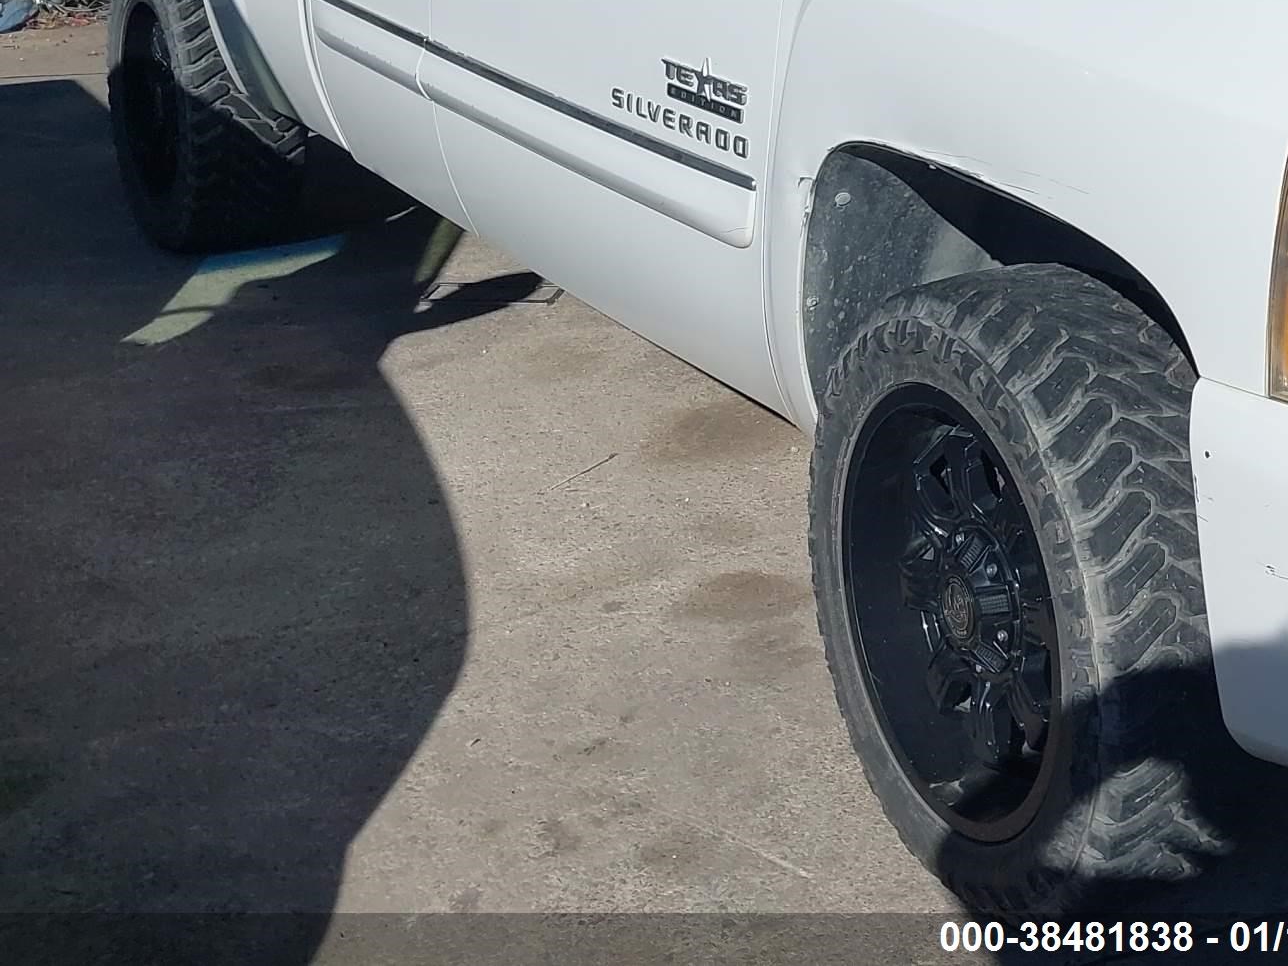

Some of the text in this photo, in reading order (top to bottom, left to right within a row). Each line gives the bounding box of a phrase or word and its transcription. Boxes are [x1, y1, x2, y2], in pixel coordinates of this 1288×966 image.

[661, 58, 749, 106] TEXAS
[669, 86, 738, 119] EDITION
[611, 87, 749, 159] SILVERADO
